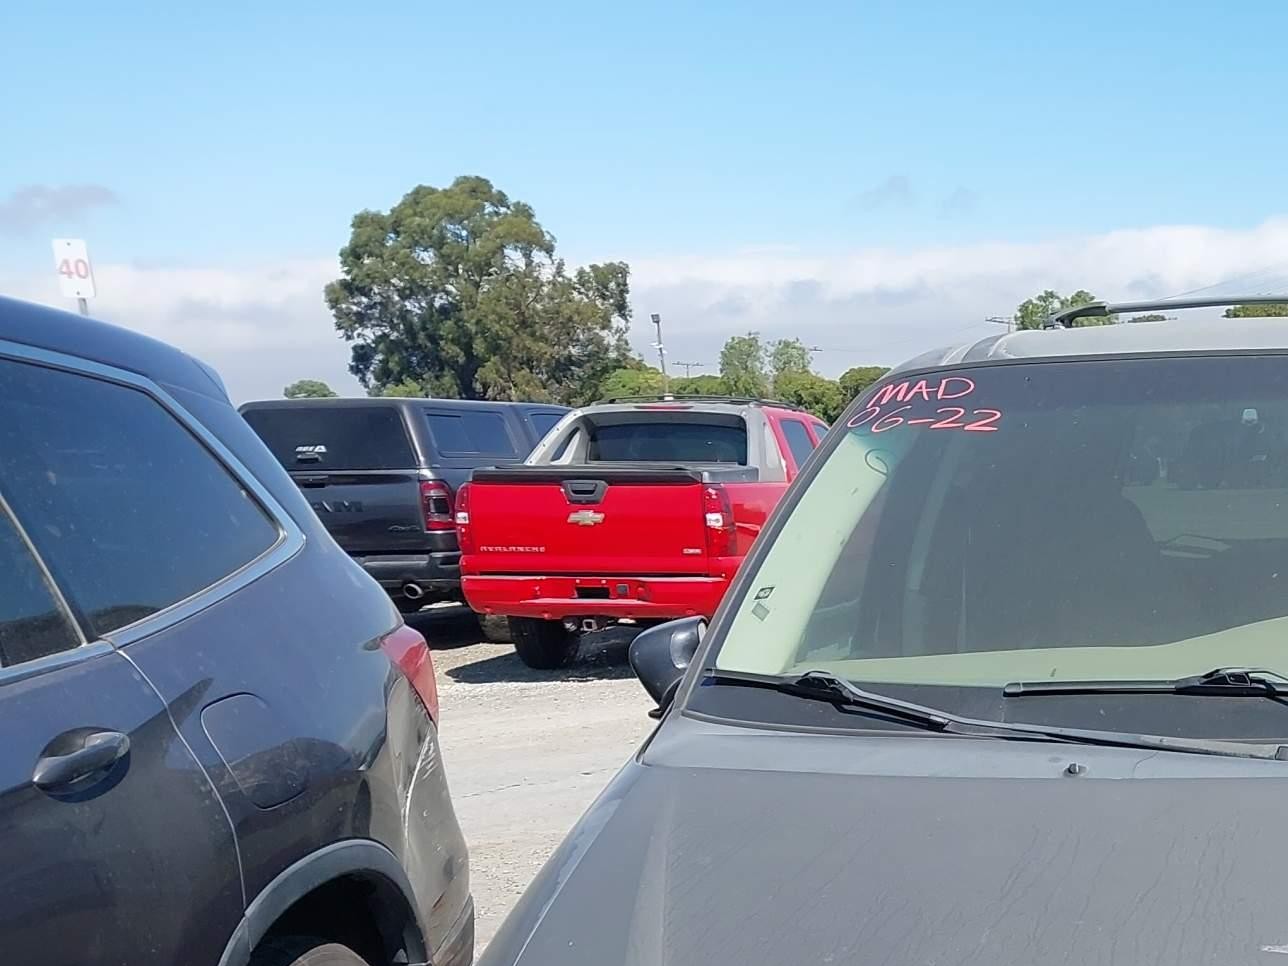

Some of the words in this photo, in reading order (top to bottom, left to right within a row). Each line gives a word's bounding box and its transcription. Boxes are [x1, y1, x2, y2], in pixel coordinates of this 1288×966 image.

[59, 258, 89, 279] 40
[866, 377, 975, 408] MAD
[847, 406, 1002, 433] 06-22
